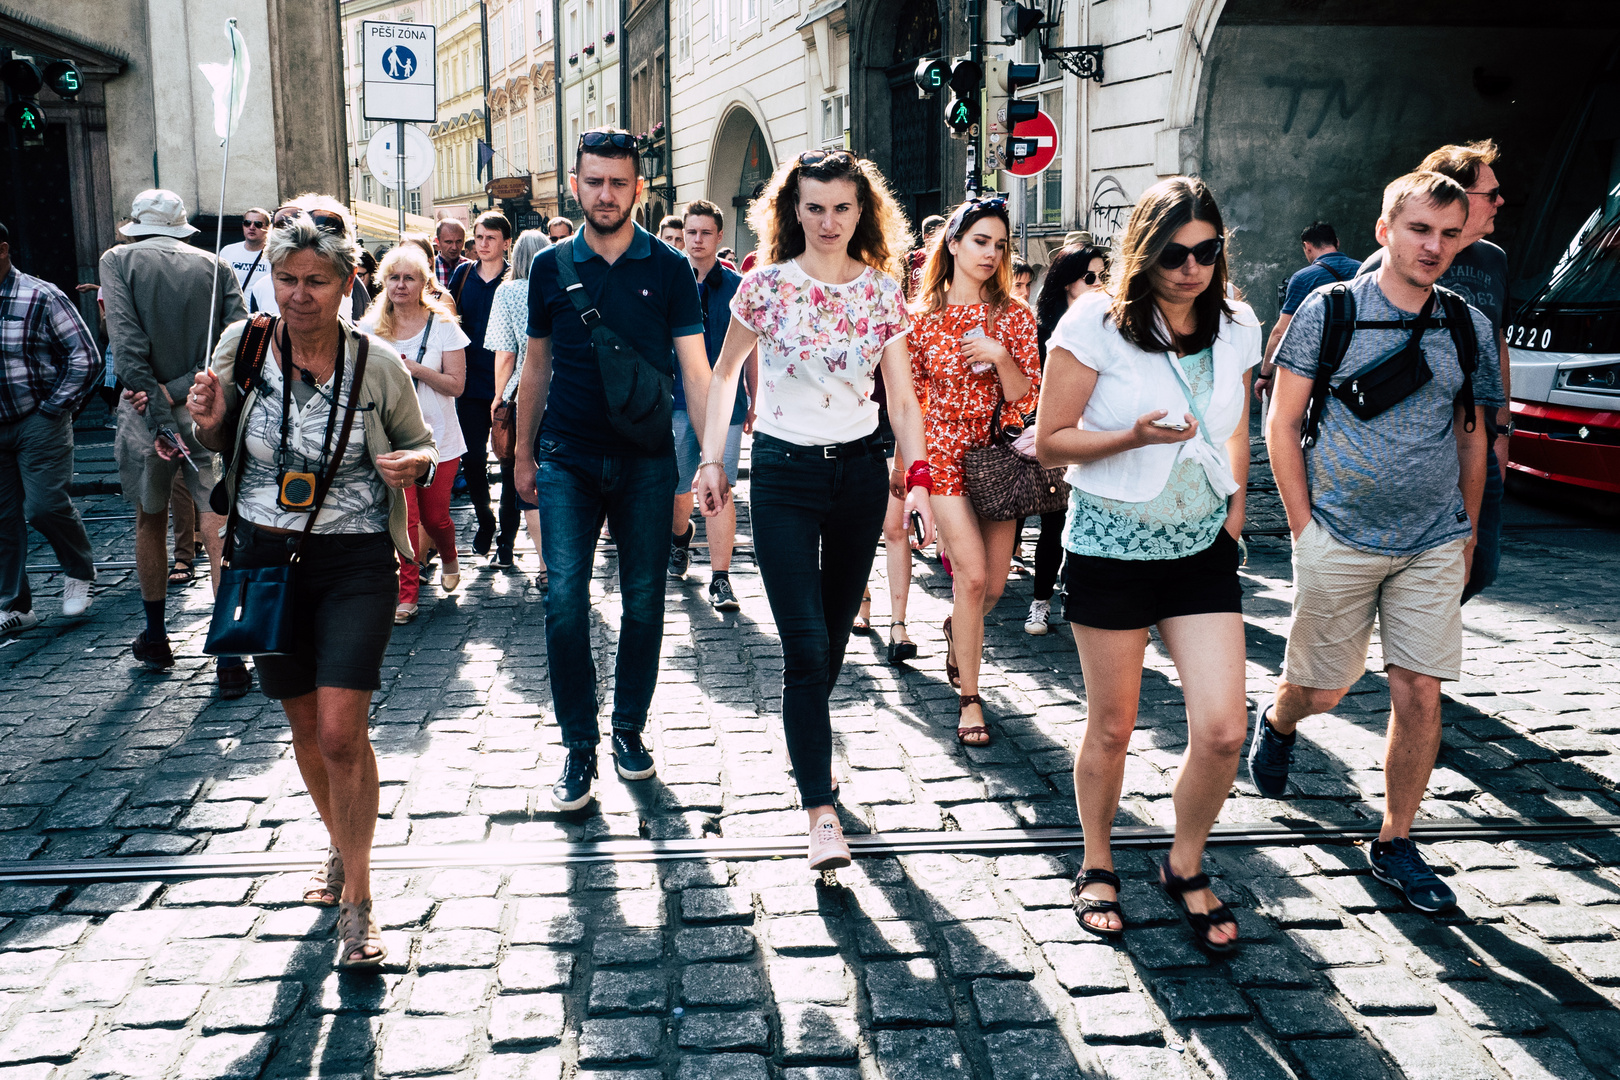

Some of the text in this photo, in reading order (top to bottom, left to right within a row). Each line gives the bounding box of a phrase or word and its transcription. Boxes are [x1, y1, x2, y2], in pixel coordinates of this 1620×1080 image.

[371, 25, 427, 40] PĚŠÍ ZÓNA
[66, 71, 78, 90] 5
[931, 69, 941, 86] 5
[1450, 265, 1492, 286] TAILOR
[1477, 292, 1496, 306] 62
[1506, 325, 1551, 349] 9220
